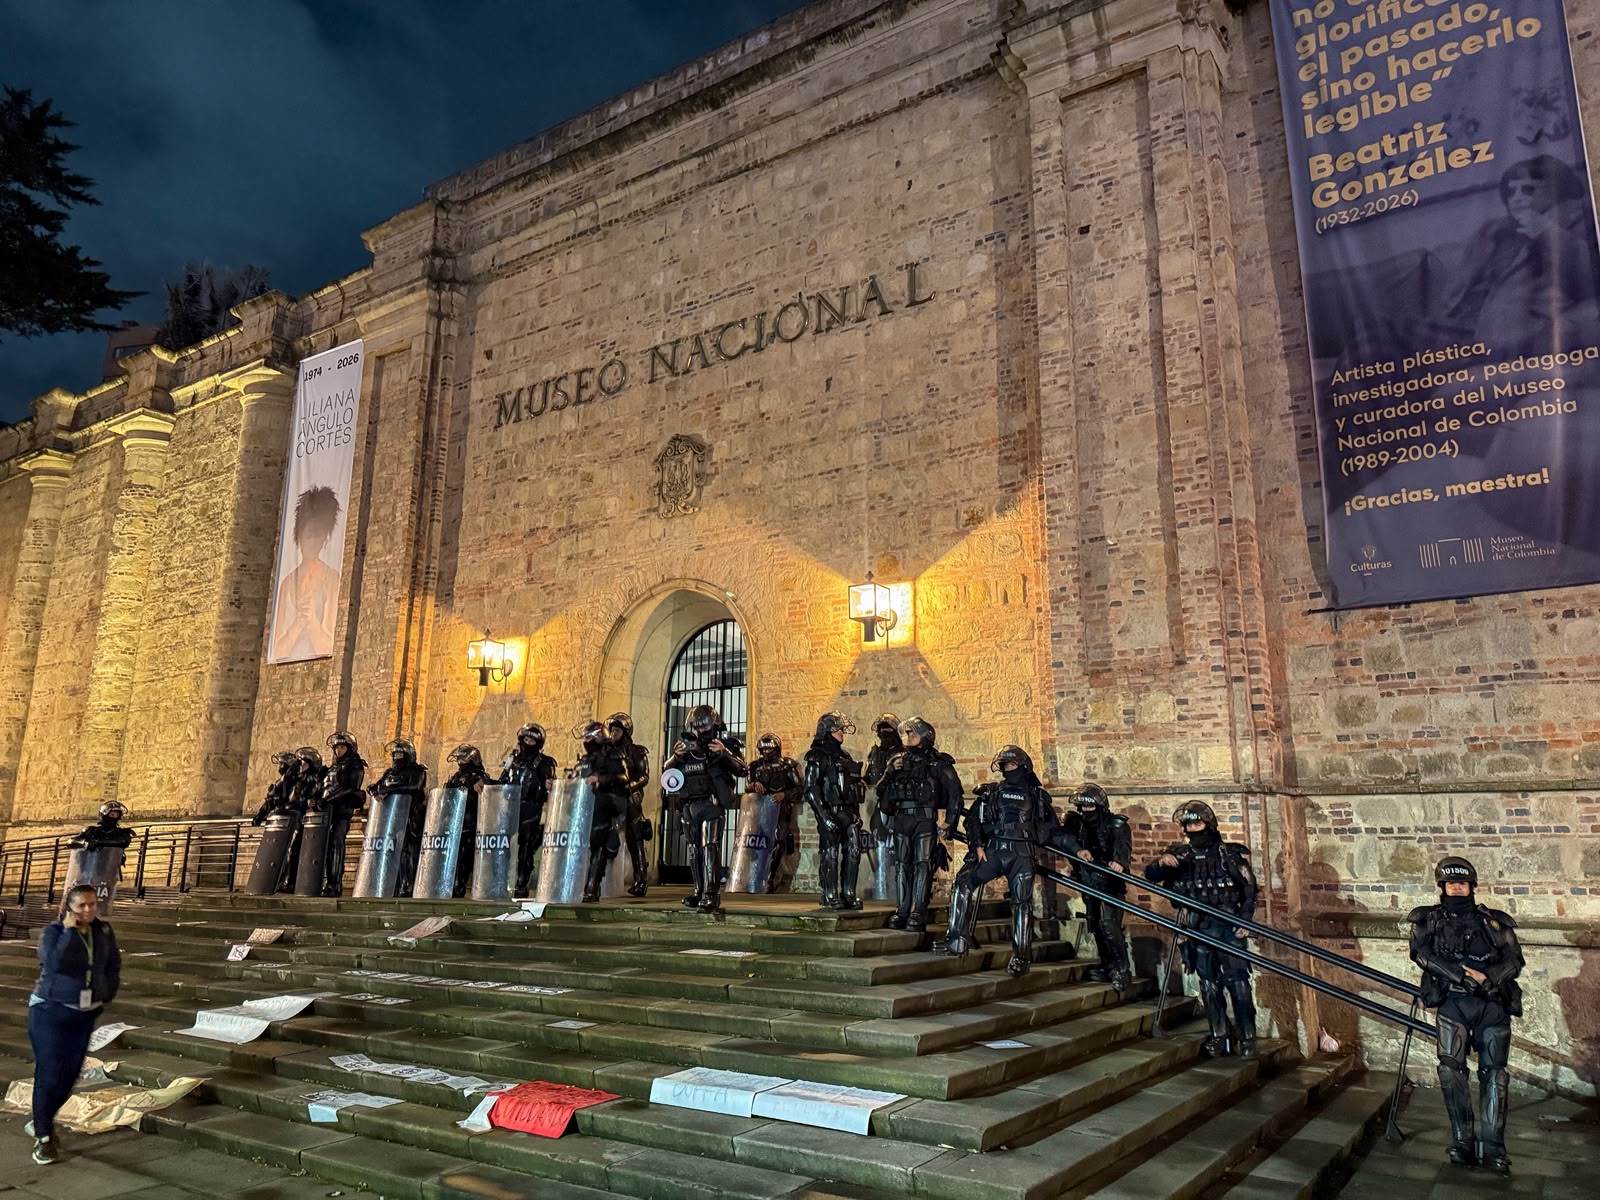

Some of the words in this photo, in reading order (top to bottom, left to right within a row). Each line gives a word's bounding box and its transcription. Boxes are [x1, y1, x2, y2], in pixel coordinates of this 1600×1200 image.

[1292, 0, 1335, 28] no
[1298, 51, 1329, 82] el
[1340, 3, 1501, 74] pasado,
[1301, 71, 1376, 110] sino
[1387, 17, 1542, 81] hacerlo
[1308, 121, 1448, 182] Beatriz
[1311, 140, 1495, 209] González
[1315, 189, 1420, 235] (1932-2026)
[303, 366, 322, 382] 1974
[337, 352, 359, 370] 2026
[494, 358, 628, 428] MUSEO
[647, 261, 937, 384] NACIONAL
[1331, 358, 1395, 386] Artista
[1402, 341, 1492, 374] plástica,
[1332, 369, 1476, 408] investigadora,
[1483, 345, 1599, 381] pedagoga
[297, 407, 354, 440] ANGULO
[300, 387, 355, 420] ILIANA
[1335, 414, 1346, 432] y
[1352, 397, 1445, 427] curadora
[1452, 386, 1485, 407] del
[1493, 376, 1566, 401] Museo
[1337, 420, 1427, 452] Nacional
[1434, 416, 1461, 433] de
[1468, 398, 1577, 428] Colombia
[1340, 438, 1460, 477] (1989-2004)
[1344, 487, 1440, 516] ¡Gracias,
[1445, 466, 1550, 498] maestra!
[1490, 535, 1524, 546] Museo
[1491, 540, 1535, 553] Nacional
[1492, 552, 1505, 561] de
[1507, 548, 1556, 560] Colombia
[1350, 560, 1392, 573] Culturas
[363, 838, 394, 851] OLICIA
